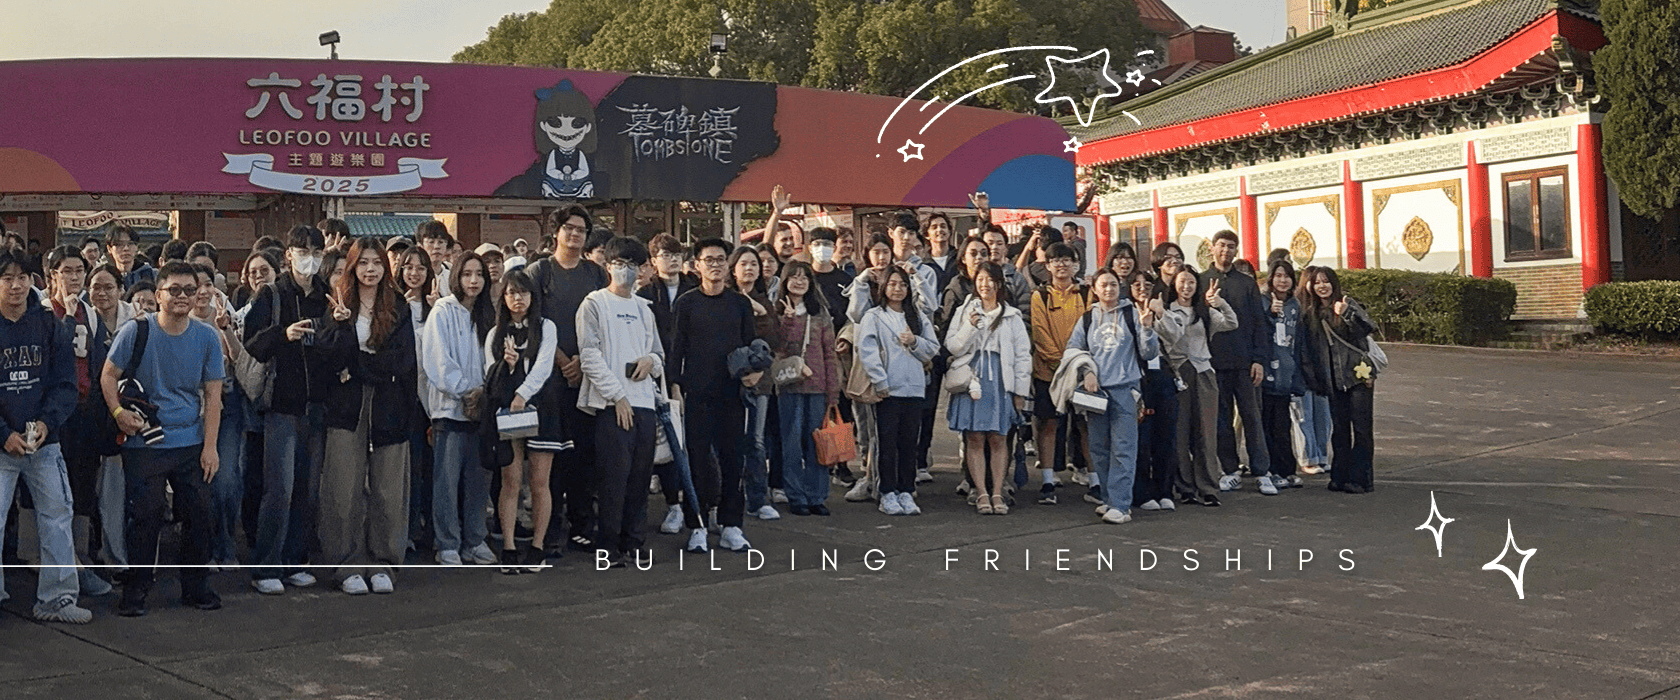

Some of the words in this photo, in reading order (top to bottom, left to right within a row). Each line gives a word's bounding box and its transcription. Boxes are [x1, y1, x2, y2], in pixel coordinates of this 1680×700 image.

[245, 71, 430, 123] 六福村
[615, 103, 740, 140] 墓碑鎮
[239, 129, 332, 146] LEOFOO
[339, 131, 432, 148] VILLAGE
[627, 131, 733, 164] TOMBSTONE
[287, 152, 386, 168] 主題遊樂園
[302, 177, 371, 193] 2025
[71, 211, 115, 228] LEOFOO
[121, 218, 163, 227] VILLAGE
